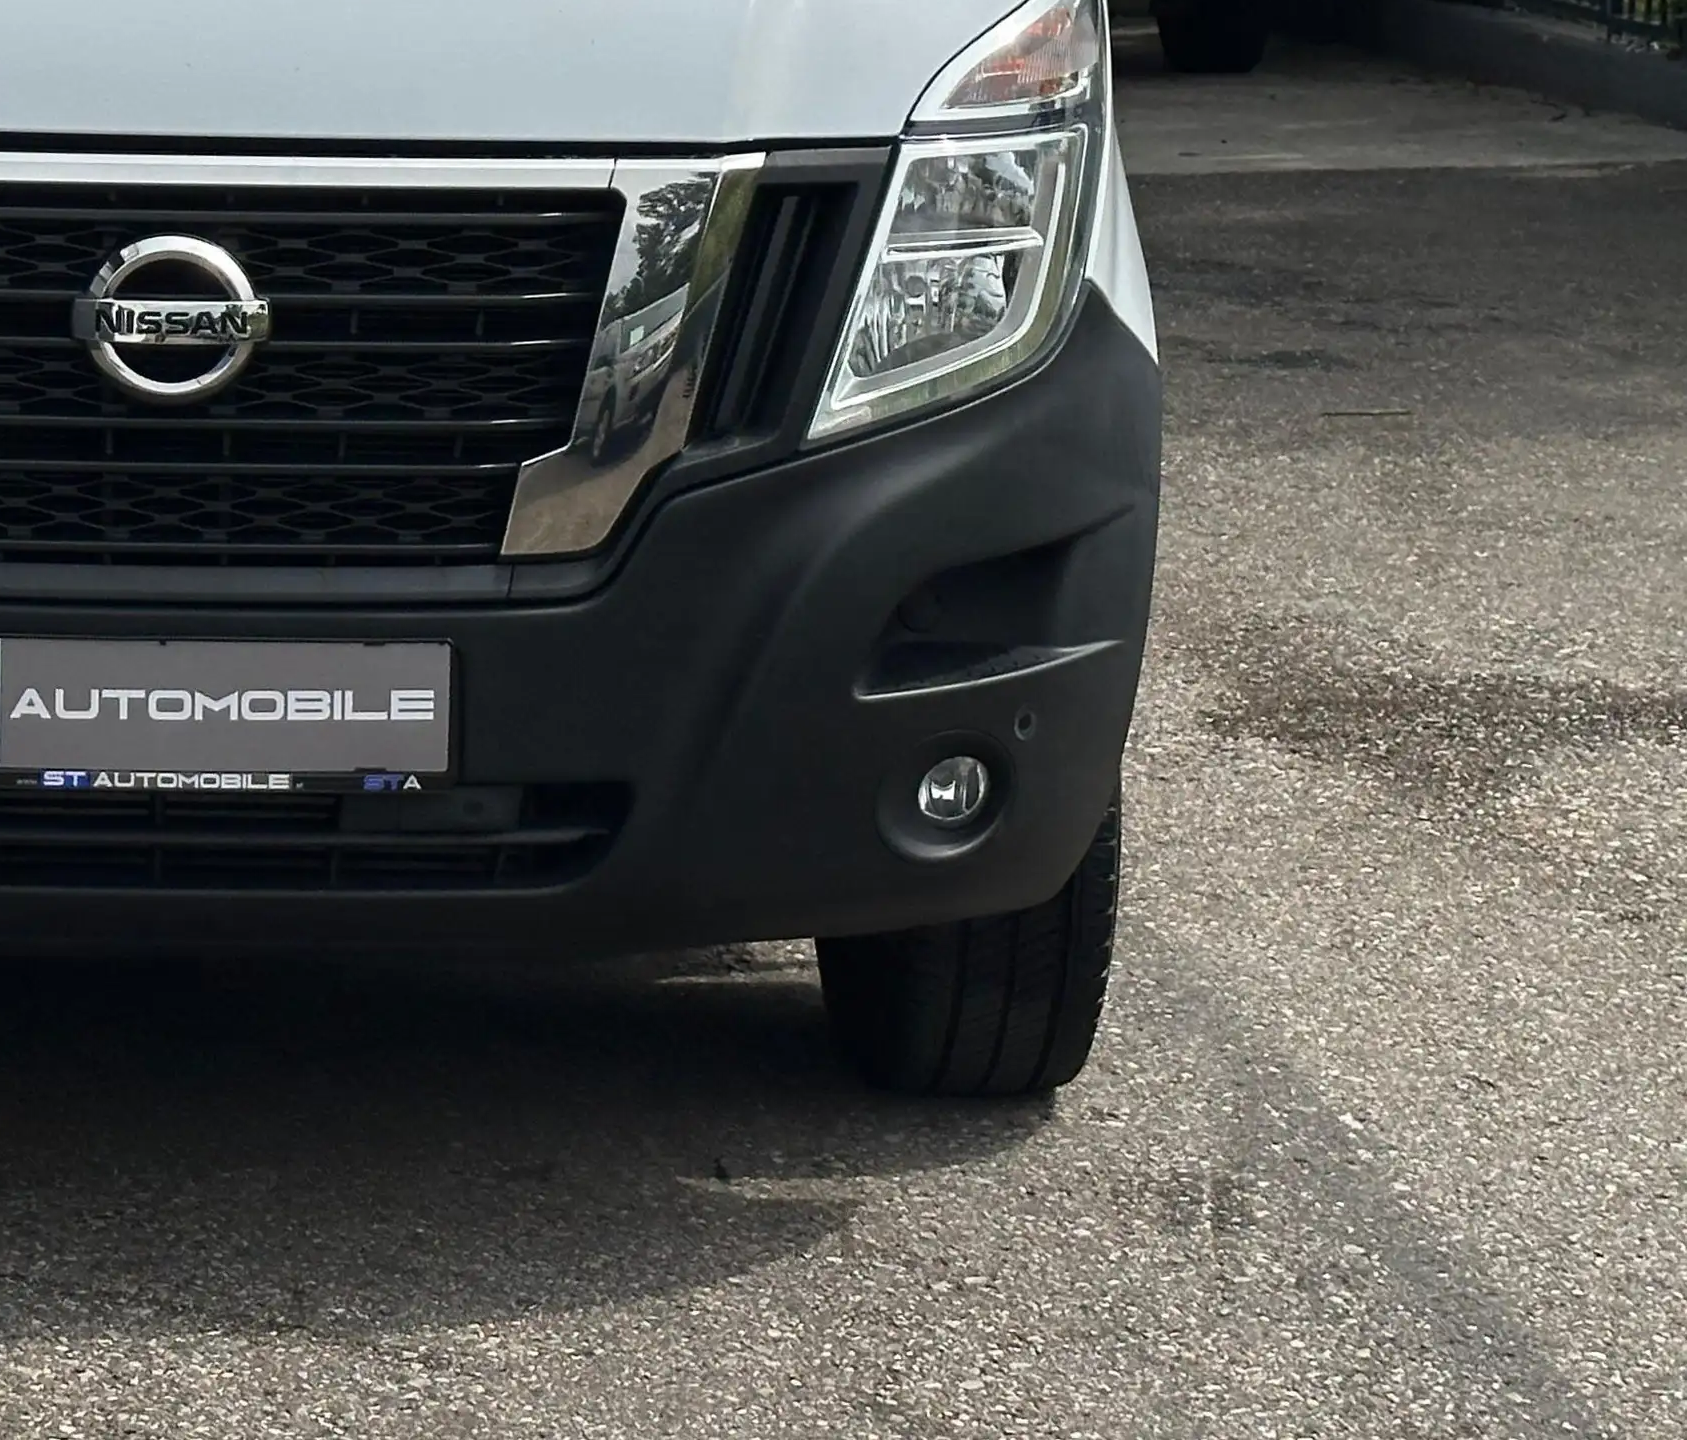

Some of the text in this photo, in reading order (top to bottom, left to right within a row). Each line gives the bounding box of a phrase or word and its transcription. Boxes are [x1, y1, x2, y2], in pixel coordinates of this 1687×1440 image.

[95, 303, 248, 335] NISSAN
[10, 687, 434, 720] AUTOMOBILE
[42, 769, 290, 790] ST AUTOMOBILE
